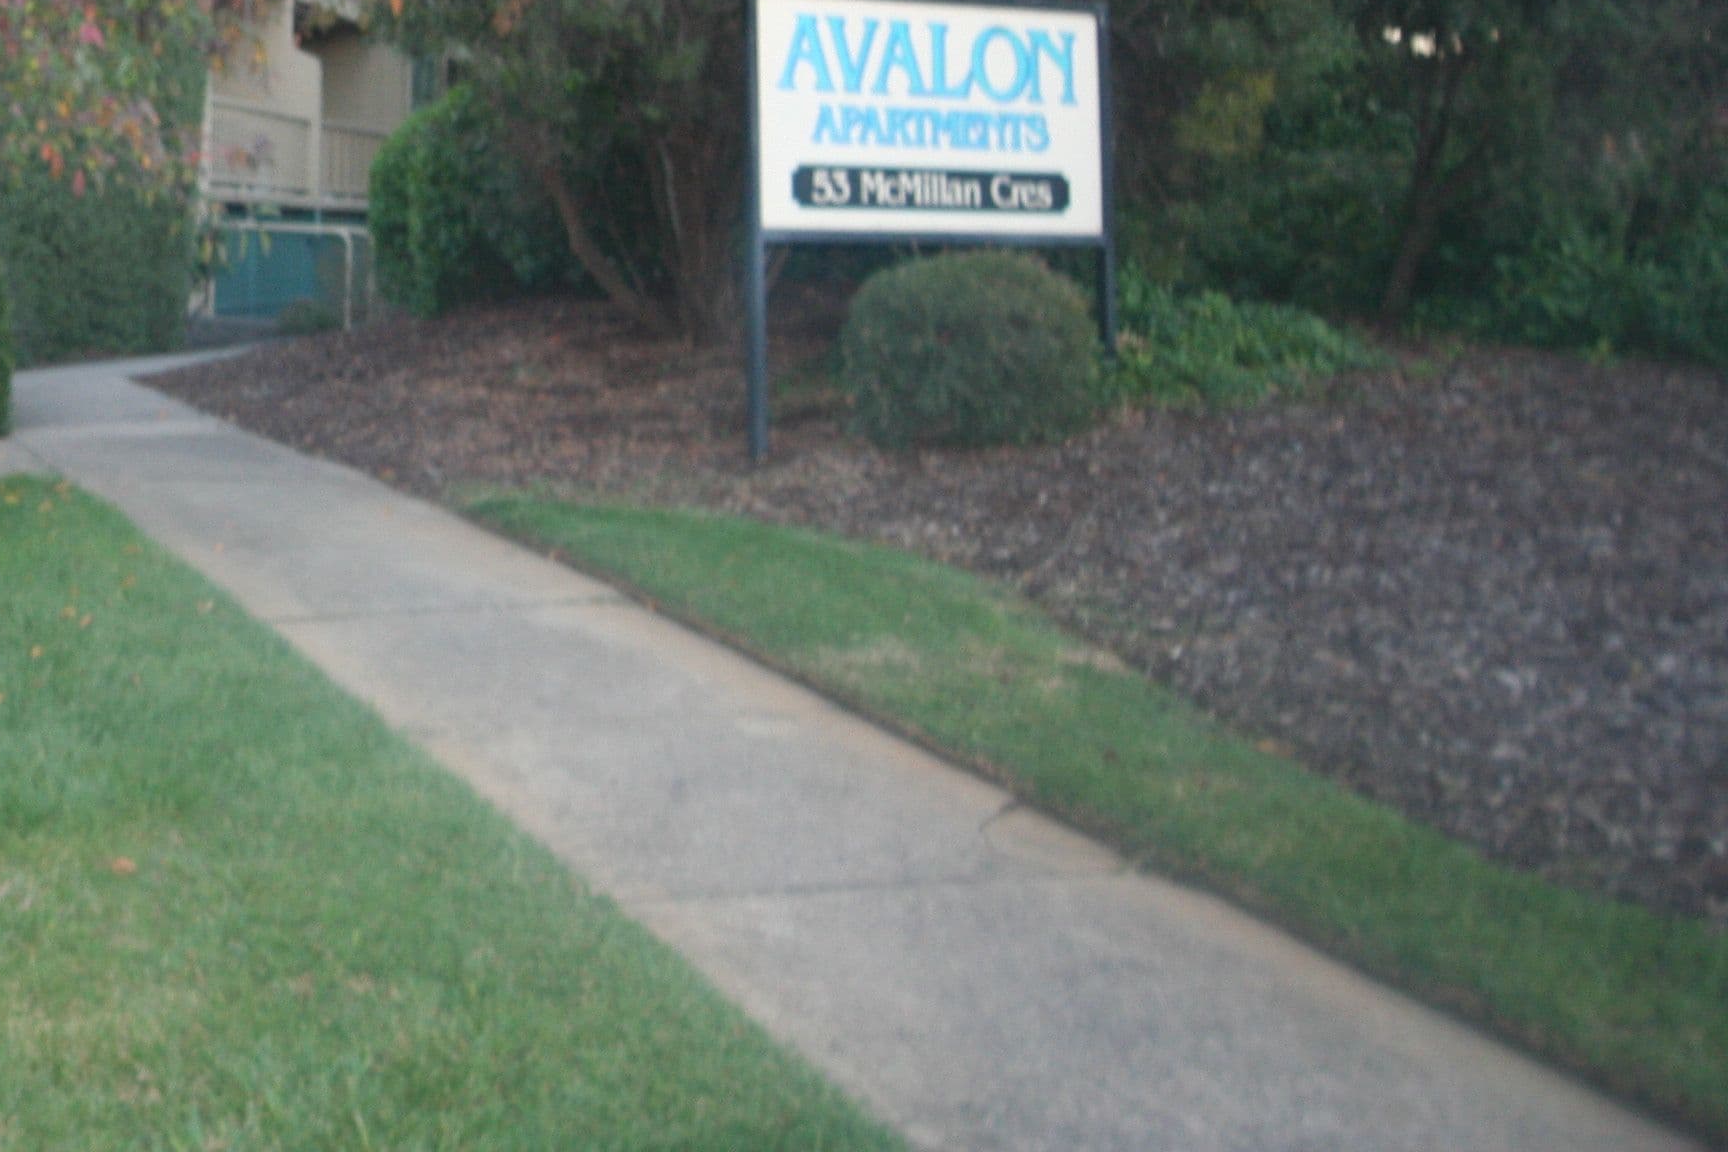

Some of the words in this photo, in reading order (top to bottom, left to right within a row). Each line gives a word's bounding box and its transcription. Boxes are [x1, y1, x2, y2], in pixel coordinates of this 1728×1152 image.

[778, 13, 1077, 105] AVALON
[812, 104, 1051, 152] APARTMENTS
[860, 171, 982, 208] McMillan
[989, 173, 1053, 209] Cres
